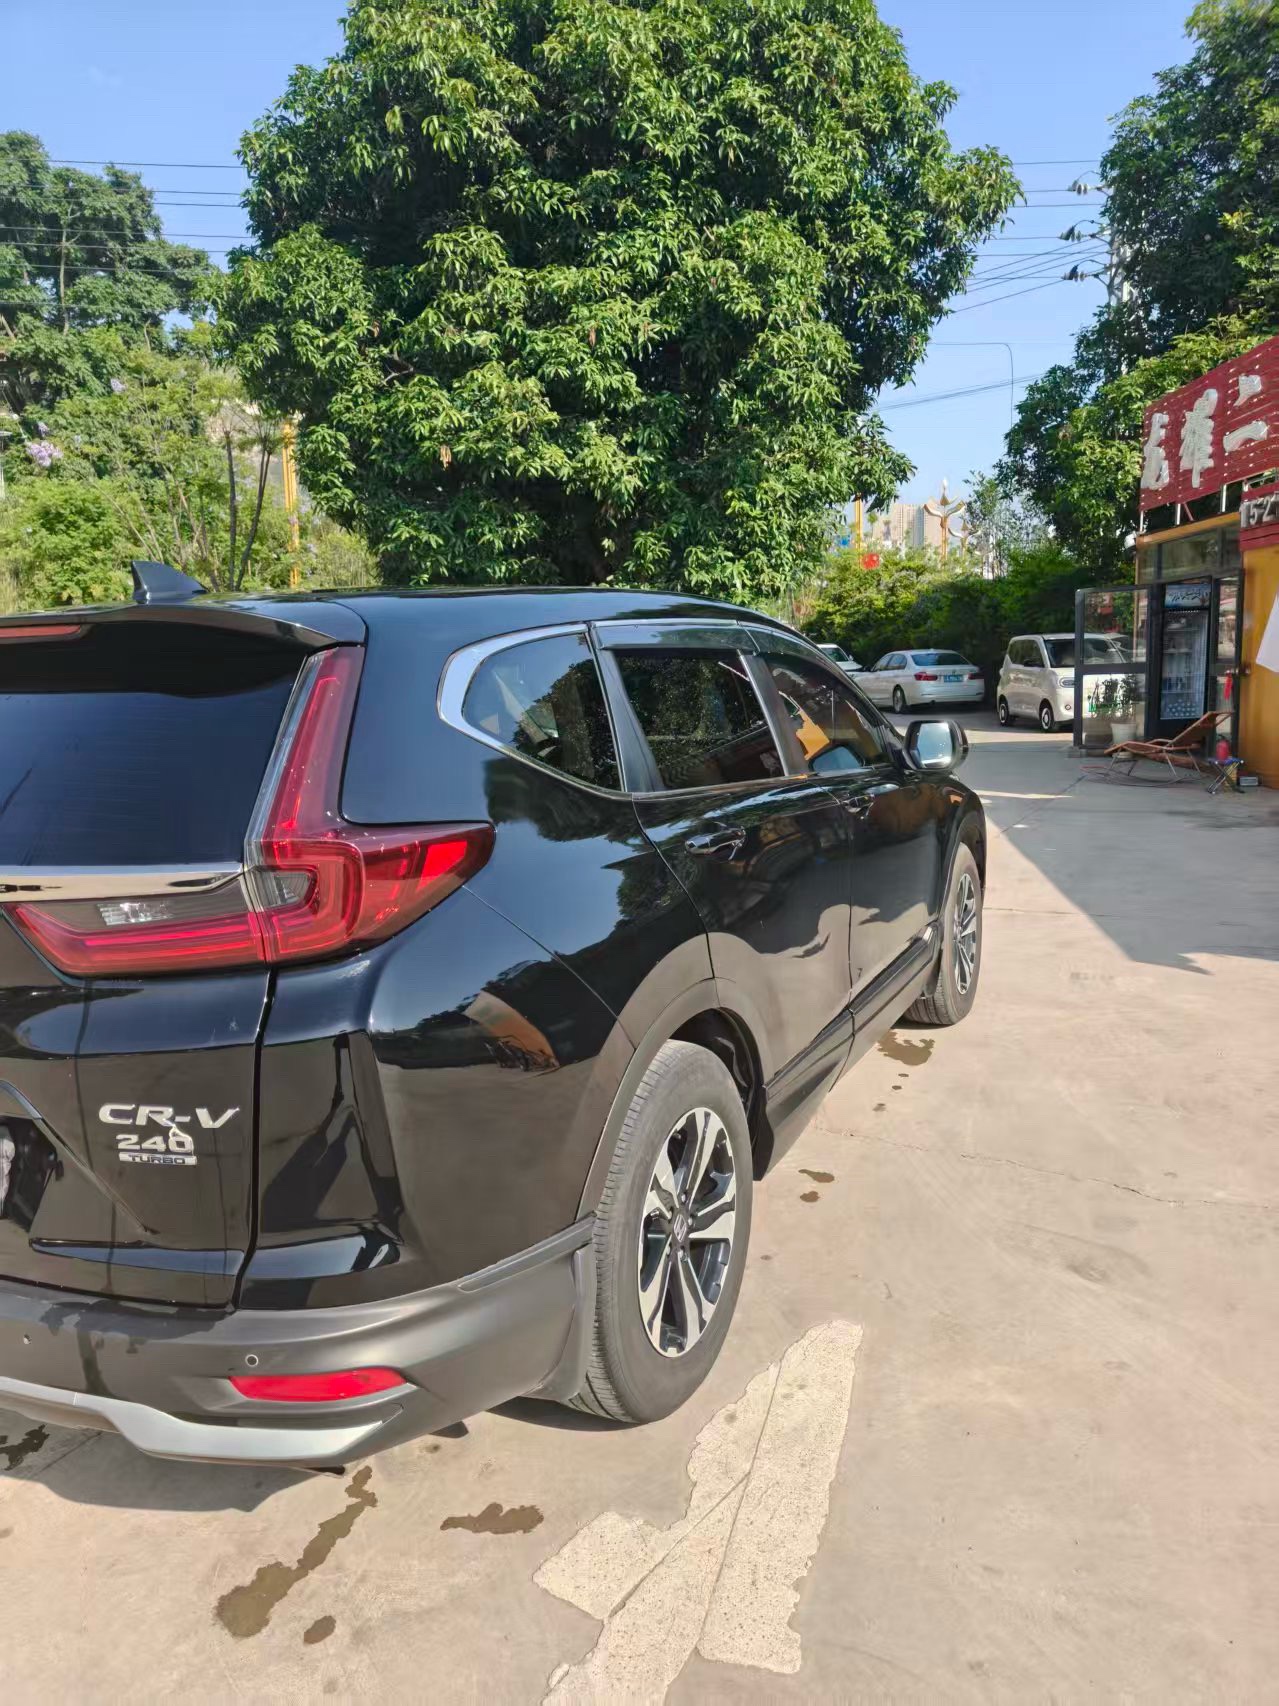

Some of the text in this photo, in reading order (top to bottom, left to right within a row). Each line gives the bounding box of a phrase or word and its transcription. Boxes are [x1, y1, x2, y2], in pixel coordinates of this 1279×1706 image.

[98, 1102, 240, 1129] CR-V
[115, 1133, 194, 1153] 240
[128, 1154, 187, 1165] TURBO
